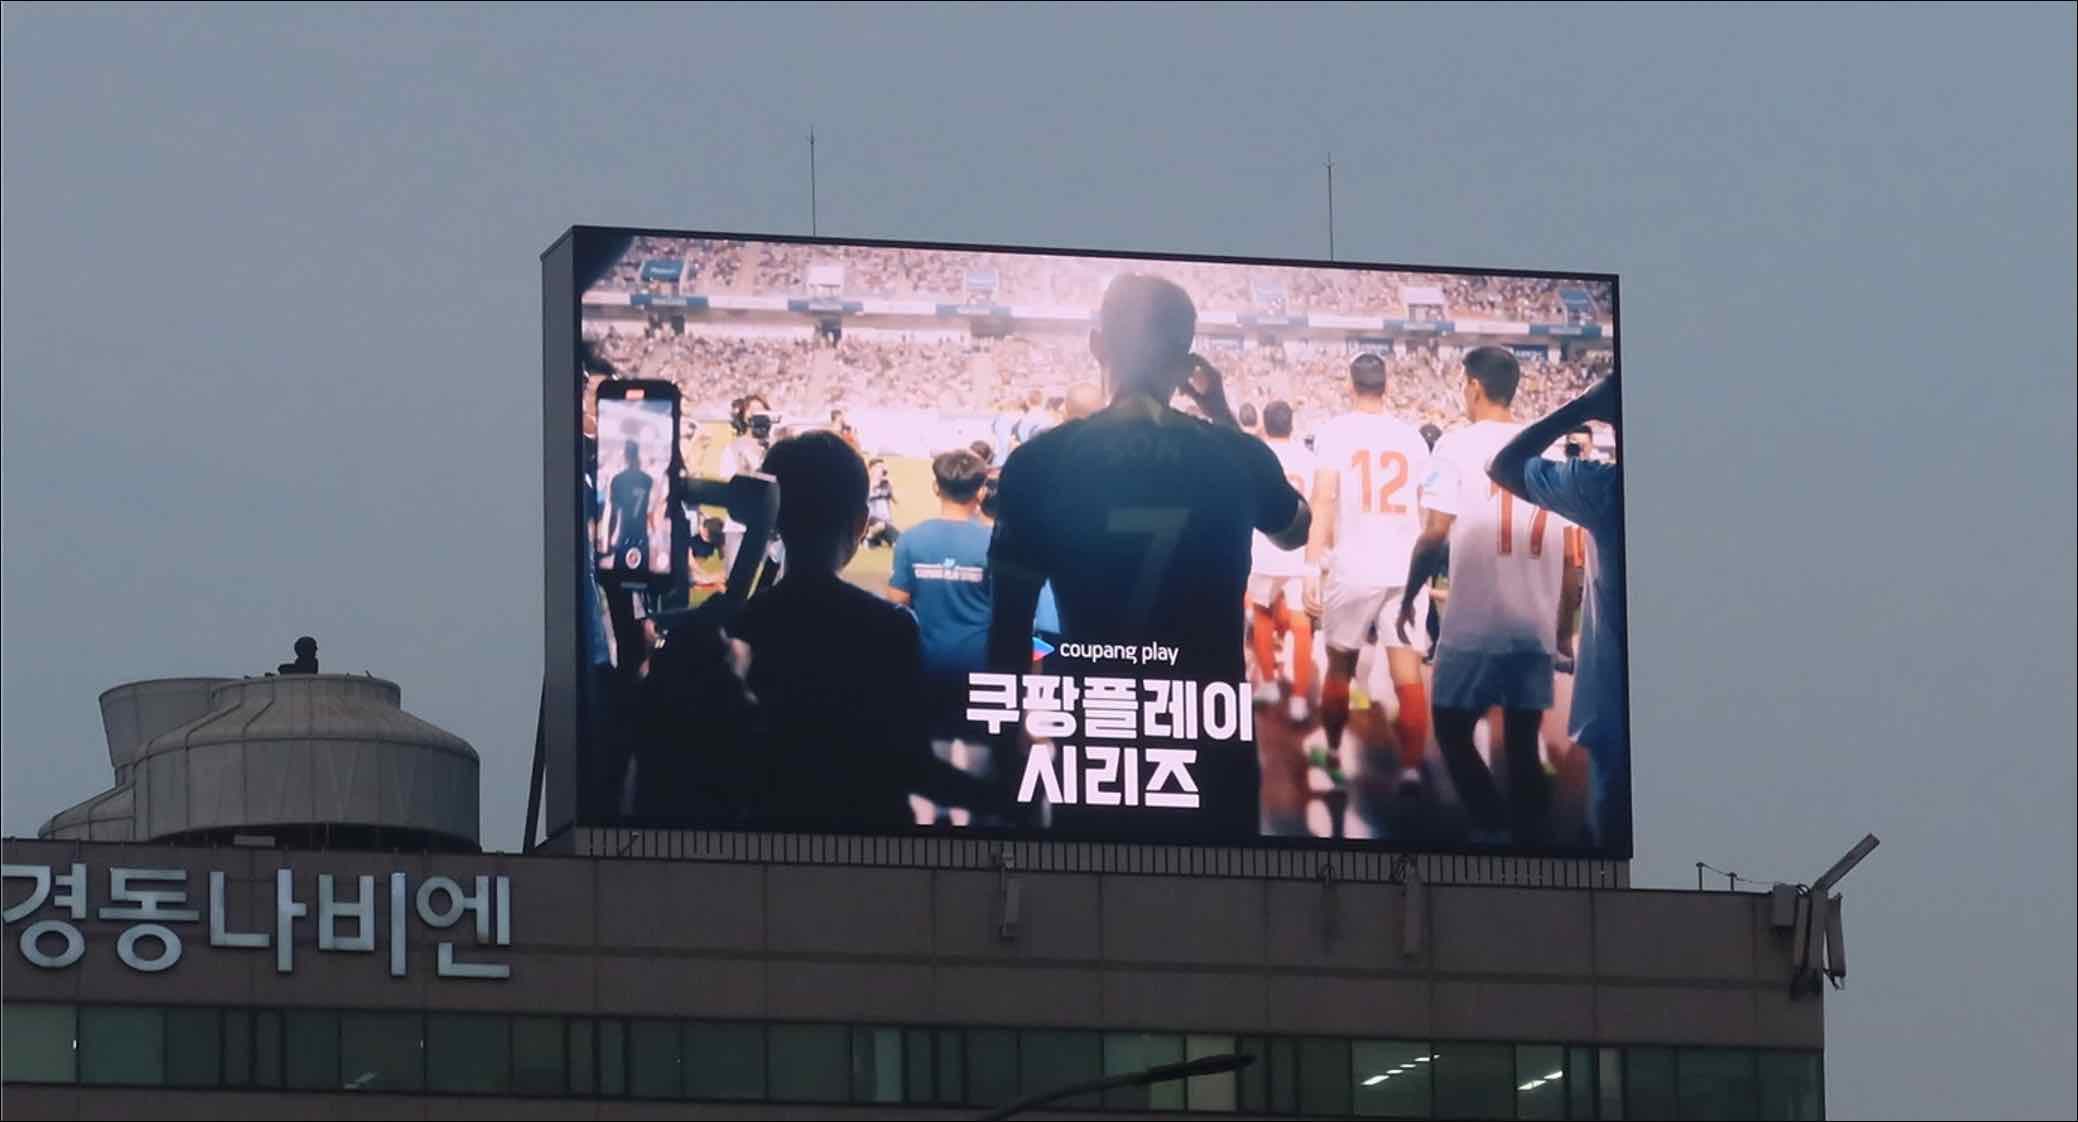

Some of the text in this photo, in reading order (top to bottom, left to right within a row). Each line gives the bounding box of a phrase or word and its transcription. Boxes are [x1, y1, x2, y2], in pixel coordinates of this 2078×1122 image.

[631, 487, 646, 518] 7
[1351, 448, 1409, 513] 12
[1106, 507, 1190, 626] 7
[1060, 641, 1178, 665] coupang play
[967, 672, 1253, 741] 쿠팡플레이
[1017, 743, 1200, 808] 시리즈
[2, 863, 511, 978] 경동나비엔
